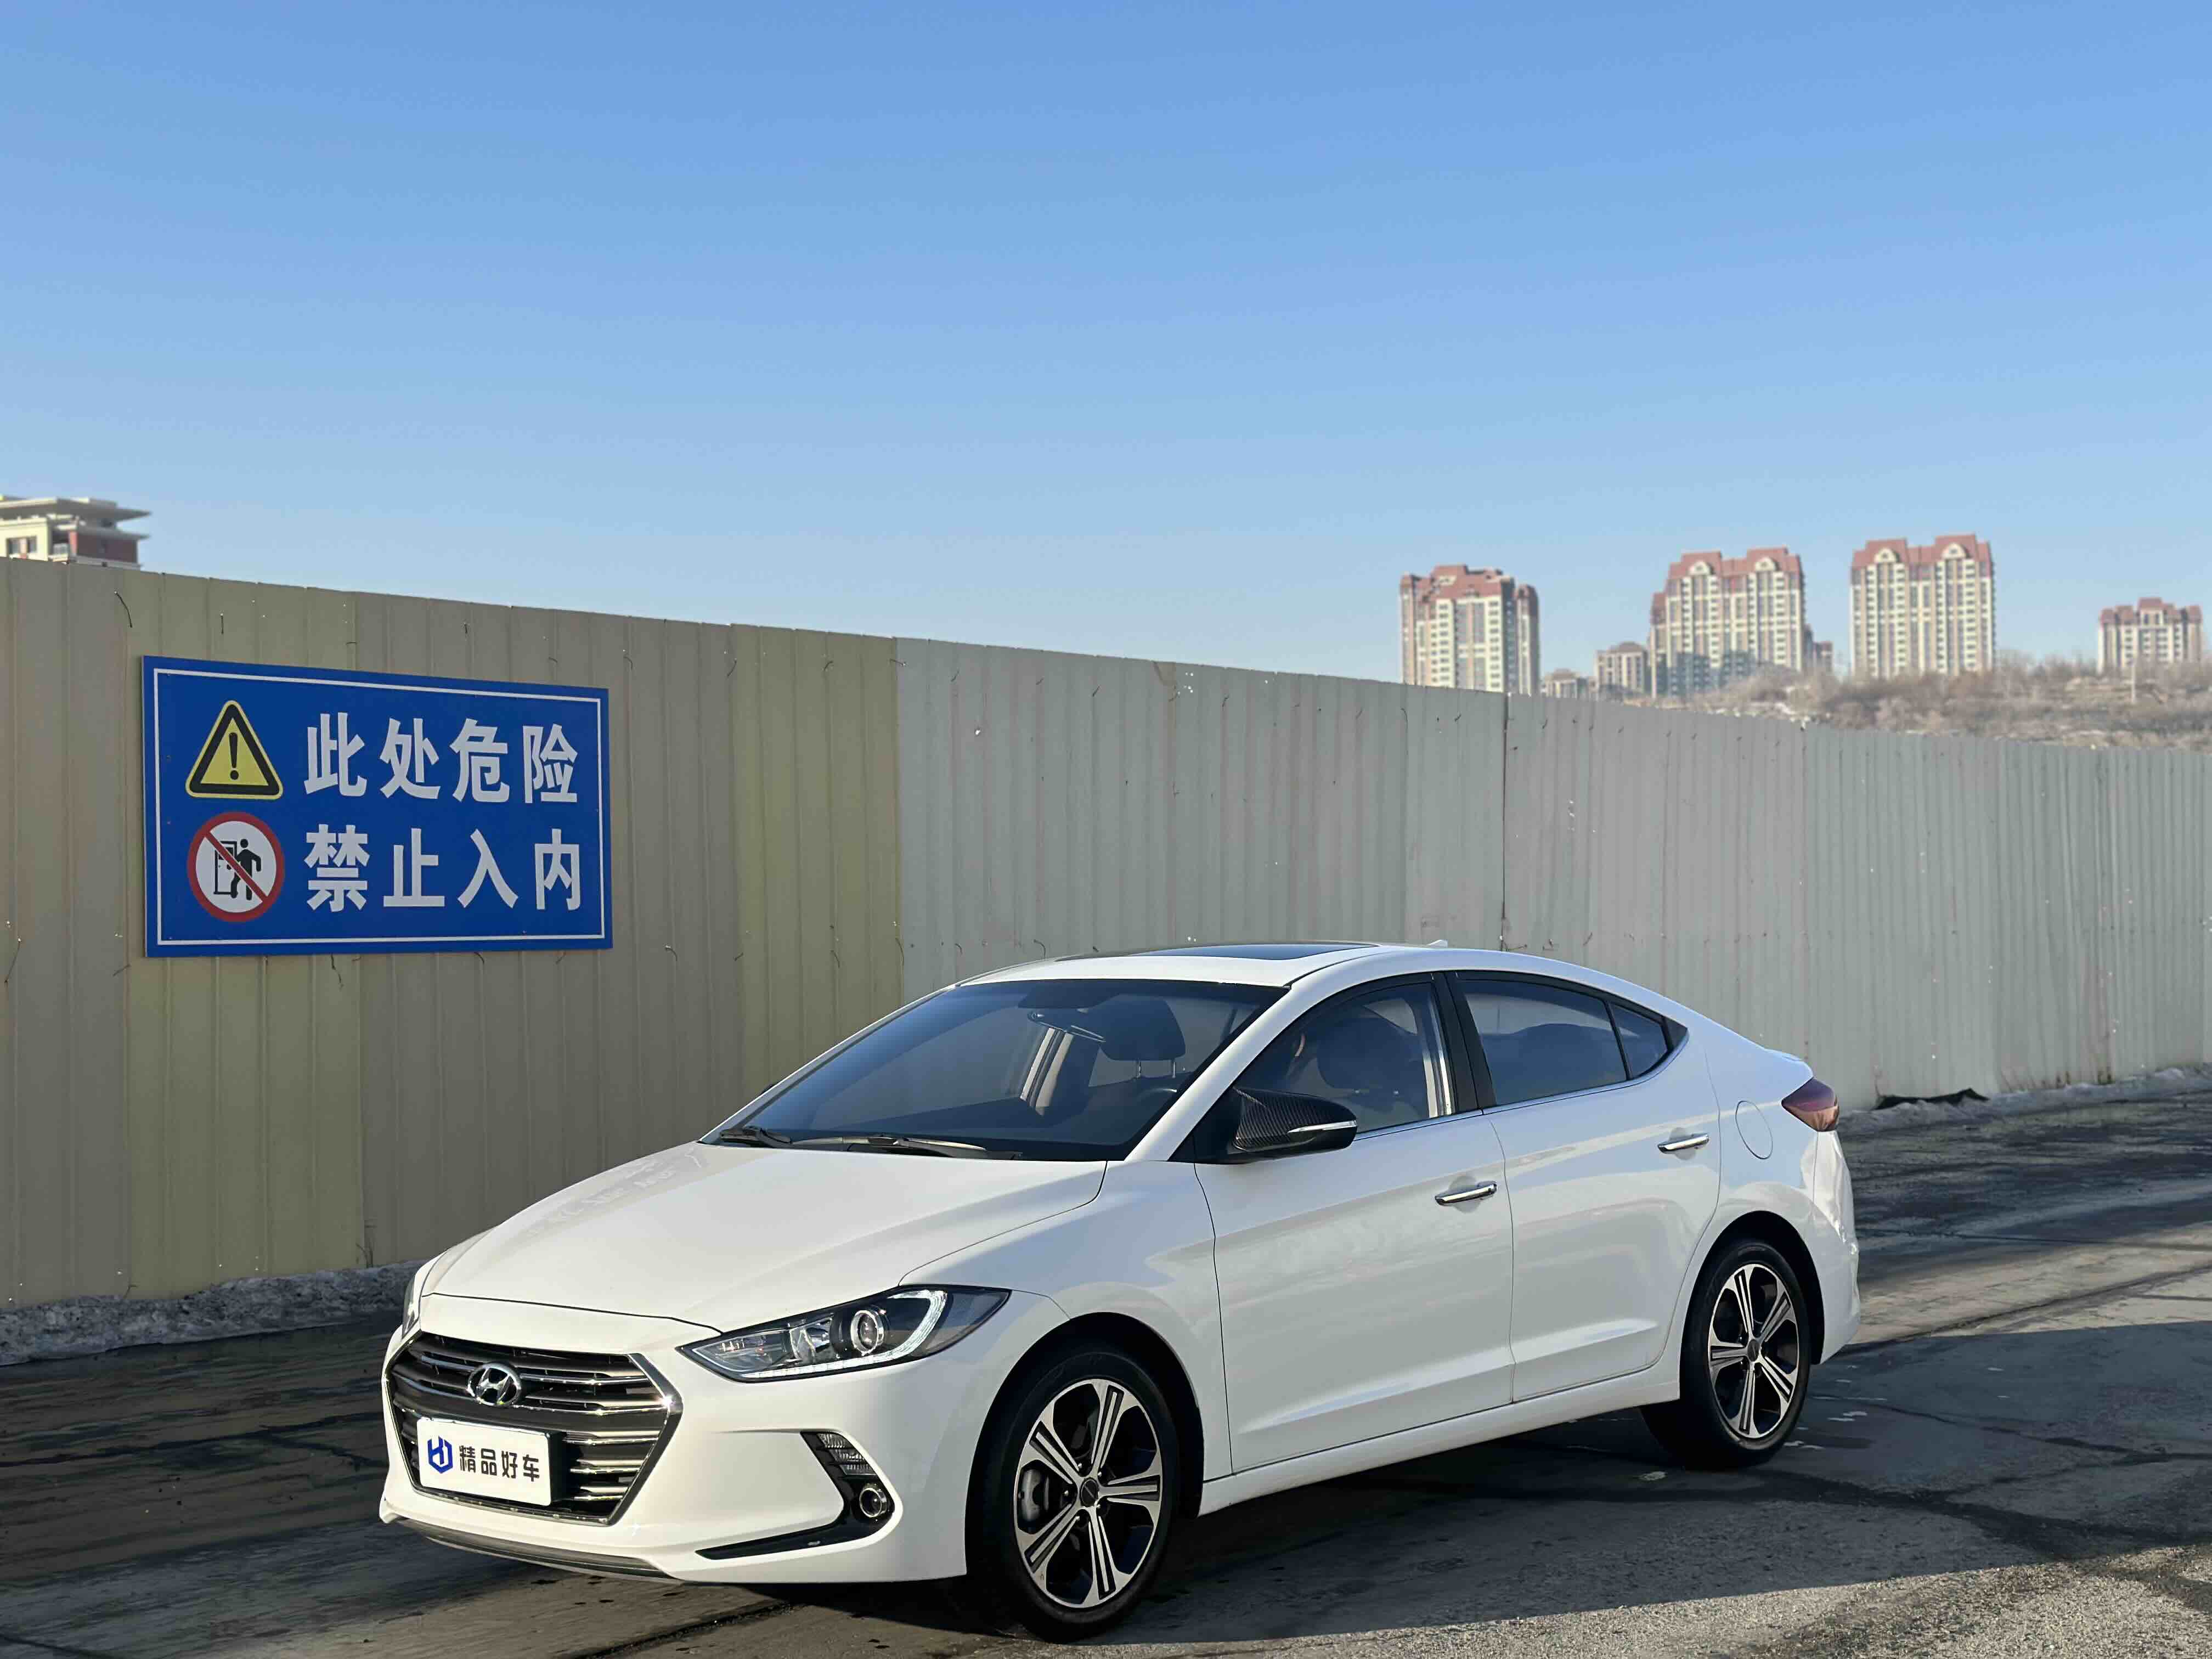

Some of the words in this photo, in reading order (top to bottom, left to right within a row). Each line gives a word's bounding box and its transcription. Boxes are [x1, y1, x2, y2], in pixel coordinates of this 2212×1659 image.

[304, 712, 578, 804] 此处危险
[304, 823, 581, 912] 禁止入内
[459, 1445, 540, 1482] 精品好车
